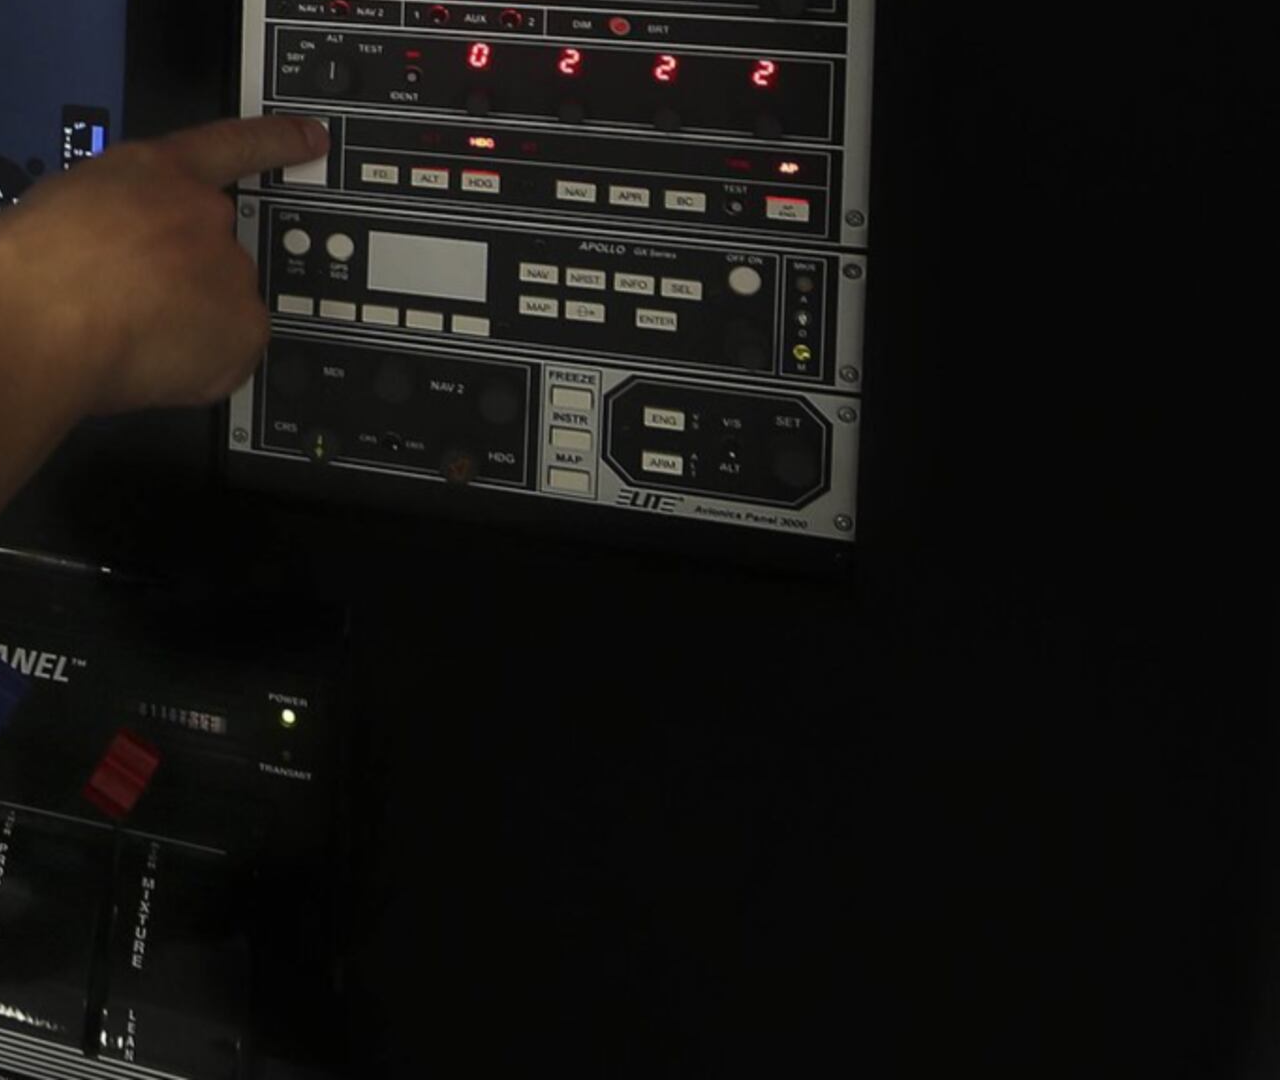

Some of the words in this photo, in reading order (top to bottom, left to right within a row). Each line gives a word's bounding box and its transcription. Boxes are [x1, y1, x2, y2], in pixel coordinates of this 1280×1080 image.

[464, 13, 487, 24] AUX
[326, 33, 344, 43] ALT
[300, 40, 315, 50] ON
[358, 44, 384, 54] TEST
[281, 65, 301, 74] OFF
[469, 42, 491, 68] 0
[559, 48, 580, 74] 2
[654, 55, 676, 81] 2
[751, 60, 775, 86] 2
[390, 91, 419, 101] IDENT
[419, 173, 440, 184] ALT
[468, 177, 494, 189] HDG
[565, 187, 588, 197] NAV
[723, 184, 748, 194] TEST
[578, 241, 627, 255] APOLLO
[526, 269, 550, 280] NAV
[620, 277, 648, 289] INFO
[671, 283, 692, 294] SEL
[525, 302, 551, 312] MAP
[549, 370, 596, 385] FREEZE
[429, 380, 455, 393] NAV
[553, 412, 589, 426] INSTR
[776, 416, 802, 429] SET
[488, 450, 517, 465] HDG
[555, 452, 582, 464] MAP
[719, 462, 741, 474] ALT
[694, 505, 742, 520] Avionics
[744, 510, 778, 526] Panel
[268, 692, 308, 708] POWER
[259, 762, 313, 782] TRANSMIT
[131, 876, 156, 970] MIXTURE
[124, 1008, 137, 1061] LEAN
